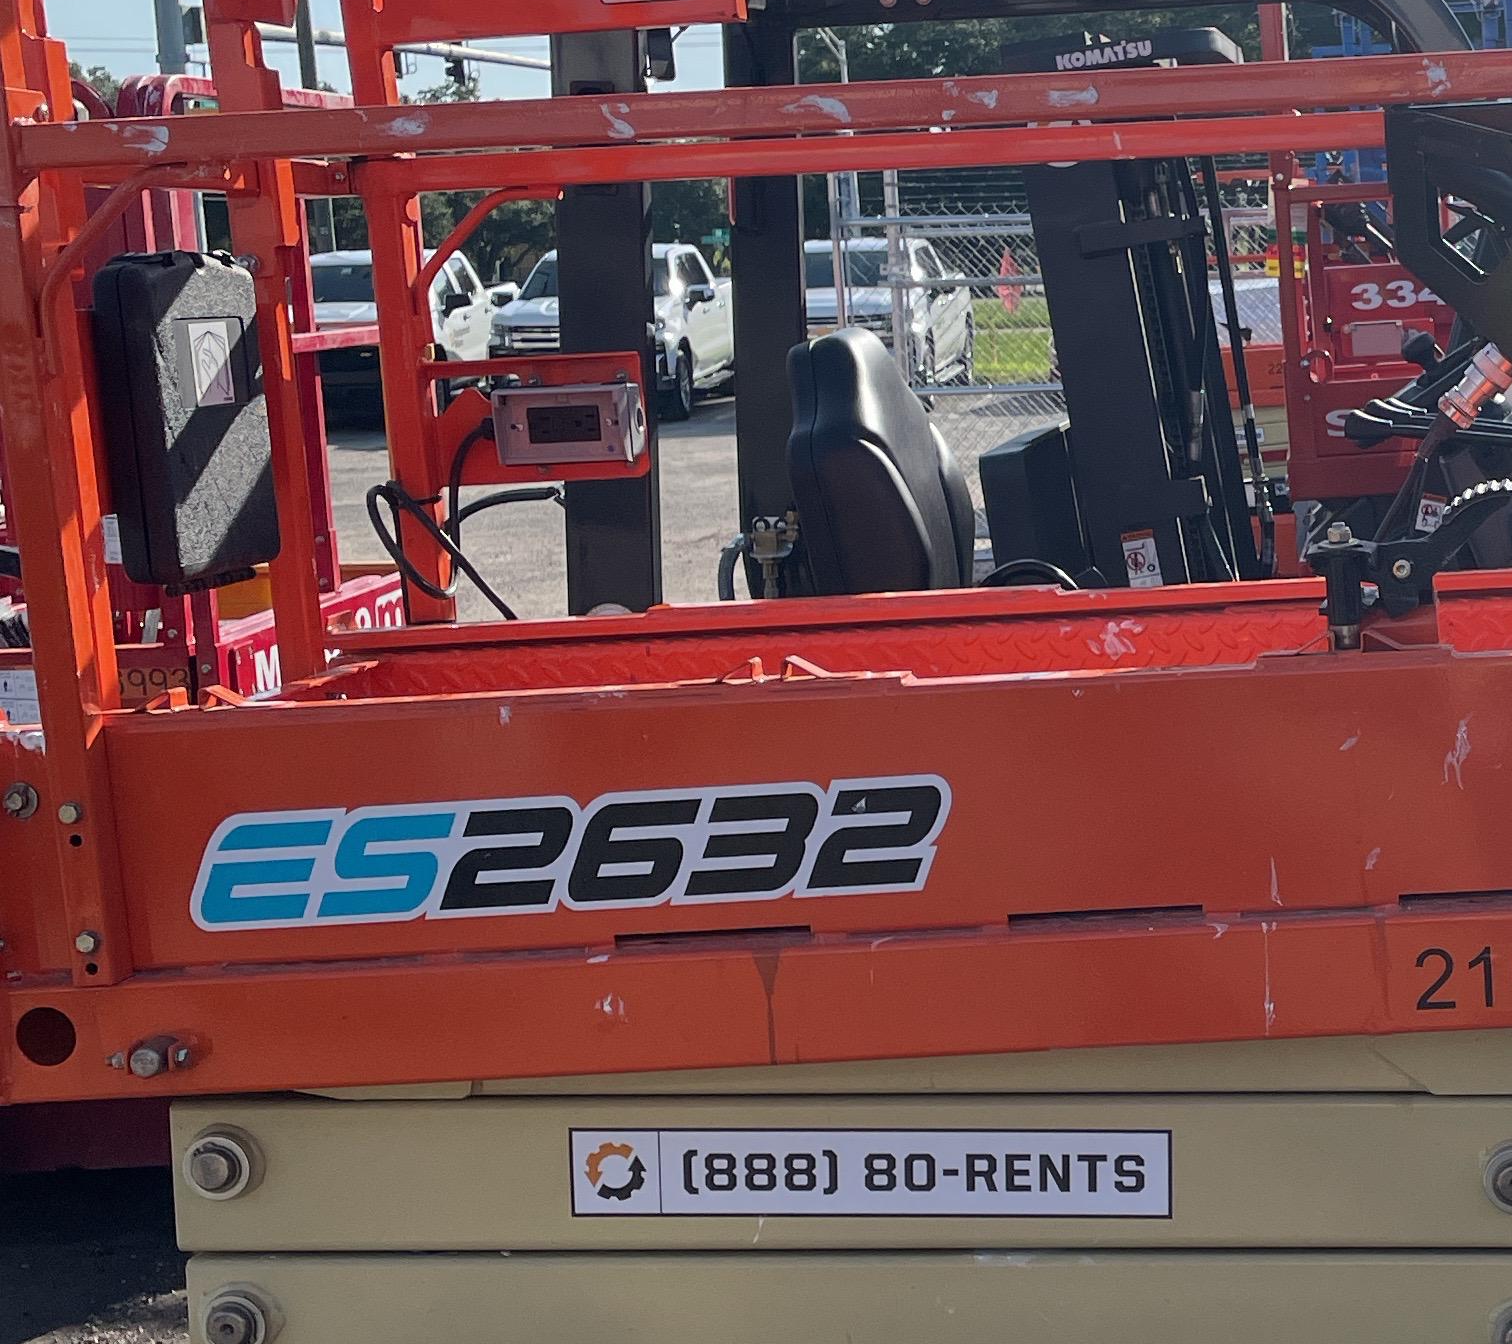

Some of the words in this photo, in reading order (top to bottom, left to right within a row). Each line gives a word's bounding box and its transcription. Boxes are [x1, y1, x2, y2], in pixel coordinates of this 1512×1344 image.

[1055, 40, 1153, 71] KOMATSU
[199, 782, 944, 926] ES2632
[682, 1148, 840, 1196] (888)
[864, 1151, 1147, 1195] 80-RENTS
